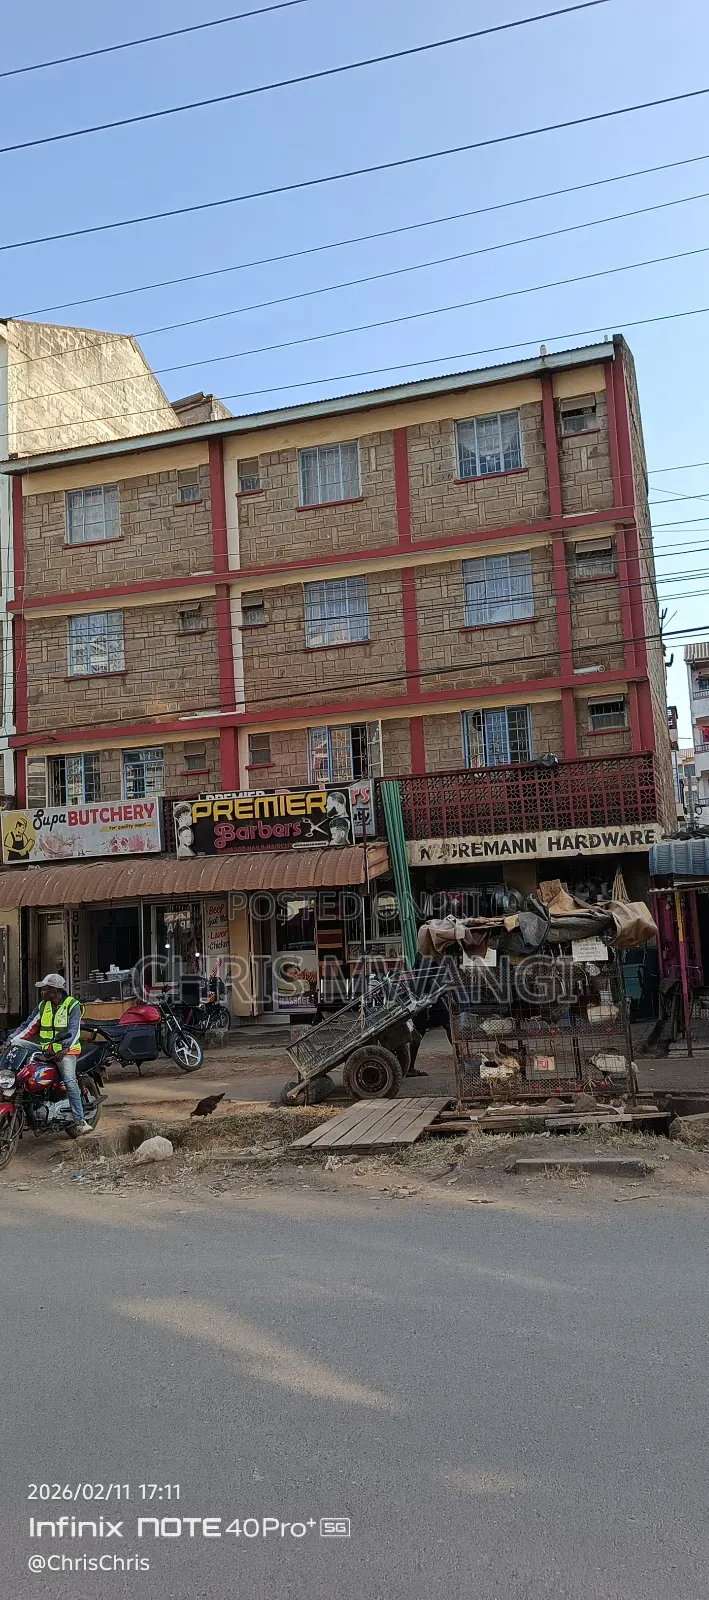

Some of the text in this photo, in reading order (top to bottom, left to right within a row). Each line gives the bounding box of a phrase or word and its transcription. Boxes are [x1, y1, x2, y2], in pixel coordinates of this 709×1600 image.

[32, 803, 156, 832] Supa BUTCHERY
[192, 792, 328, 824] PREMIER
[213, 821, 301, 849] Barbers
[547, 829, 656, 853] HARDWARE
[208, 904, 224, 915] Beef
[210, 929, 229, 940] Liver
